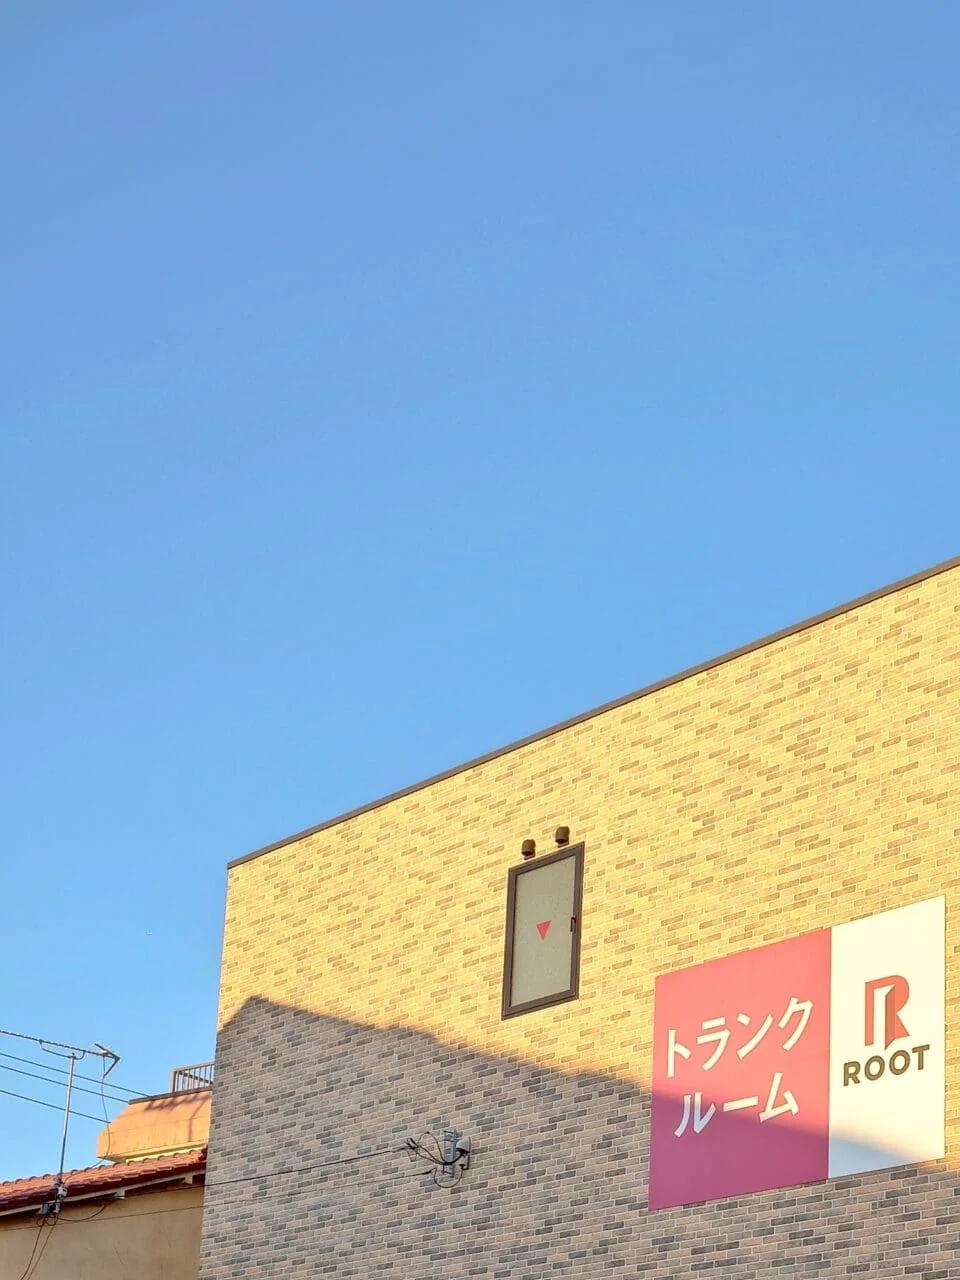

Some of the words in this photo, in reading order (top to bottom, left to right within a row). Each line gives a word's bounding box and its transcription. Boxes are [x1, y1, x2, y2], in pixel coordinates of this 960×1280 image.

[667, 997, 814, 1078] トランク
[842, 1043, 931, 1088] ROOT
[673, 1071, 800, 1138] ルーム
